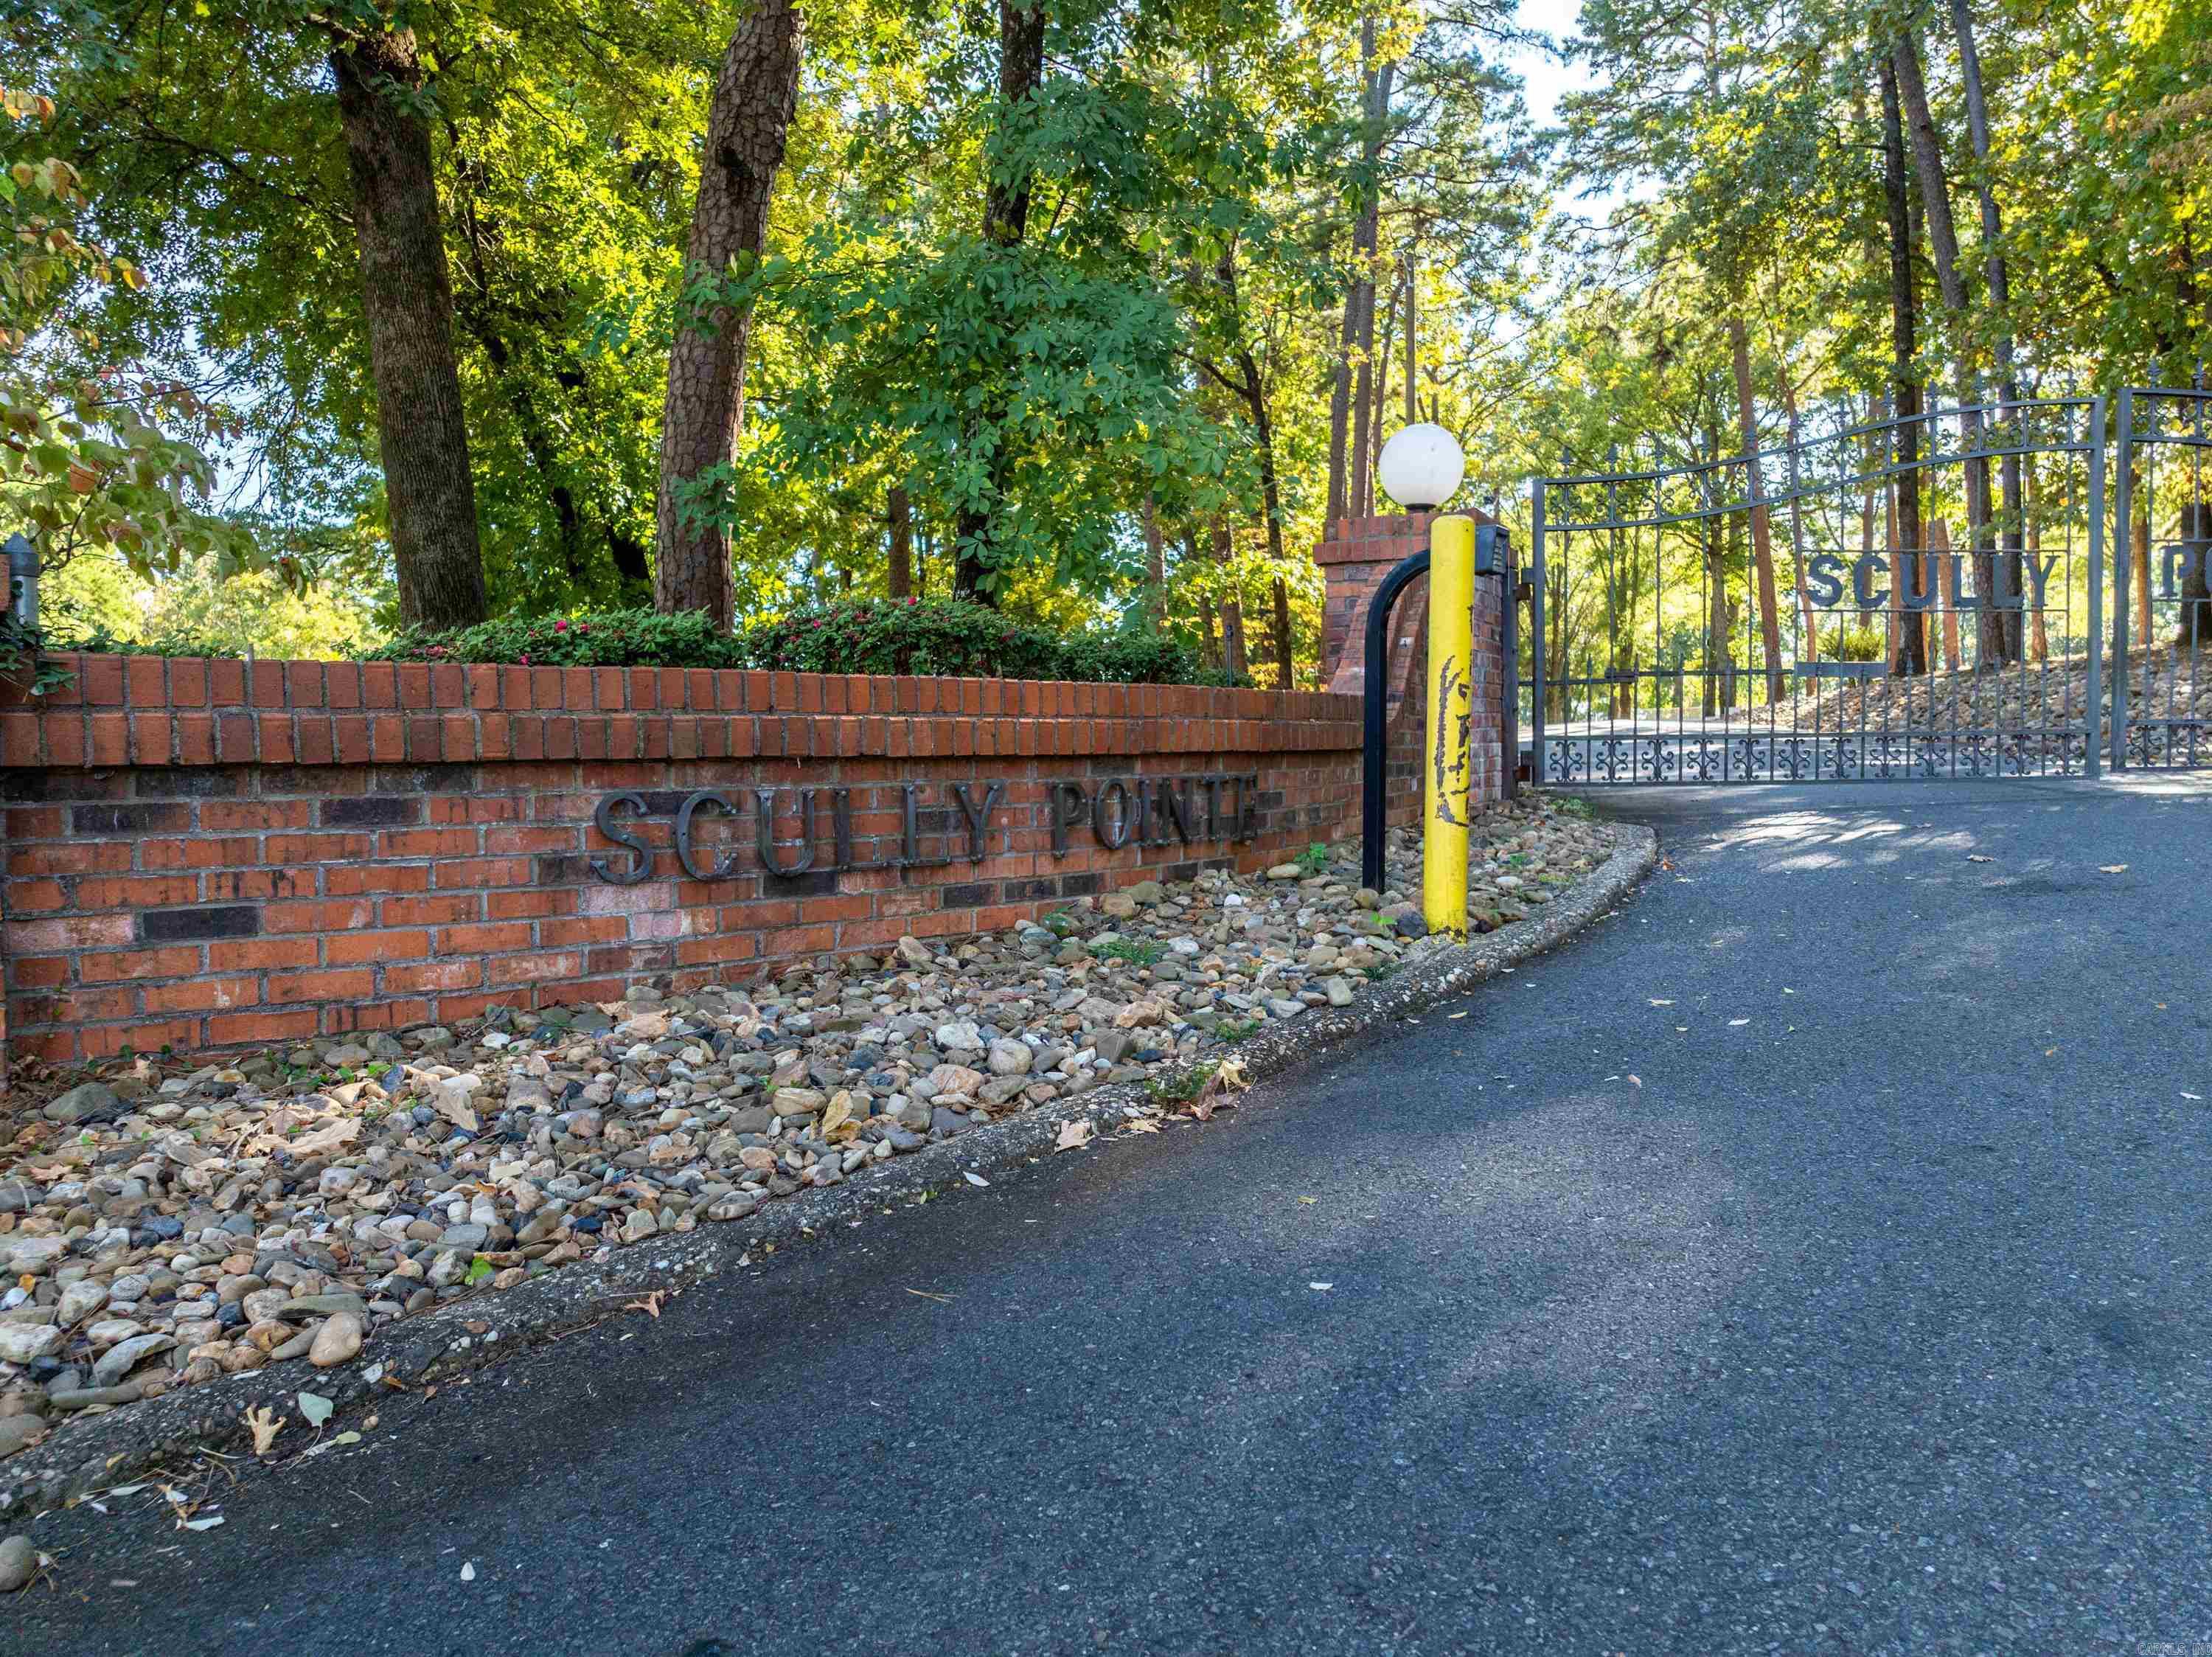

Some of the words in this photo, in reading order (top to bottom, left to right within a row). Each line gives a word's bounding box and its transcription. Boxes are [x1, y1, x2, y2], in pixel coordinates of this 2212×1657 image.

[1808, 552, 2061, 608] SCULLY
[2158, 544, 2212, 598] P
[591, 779, 1007, 885] SCULLY
[1053, 774, 1258, 858] POINTE
